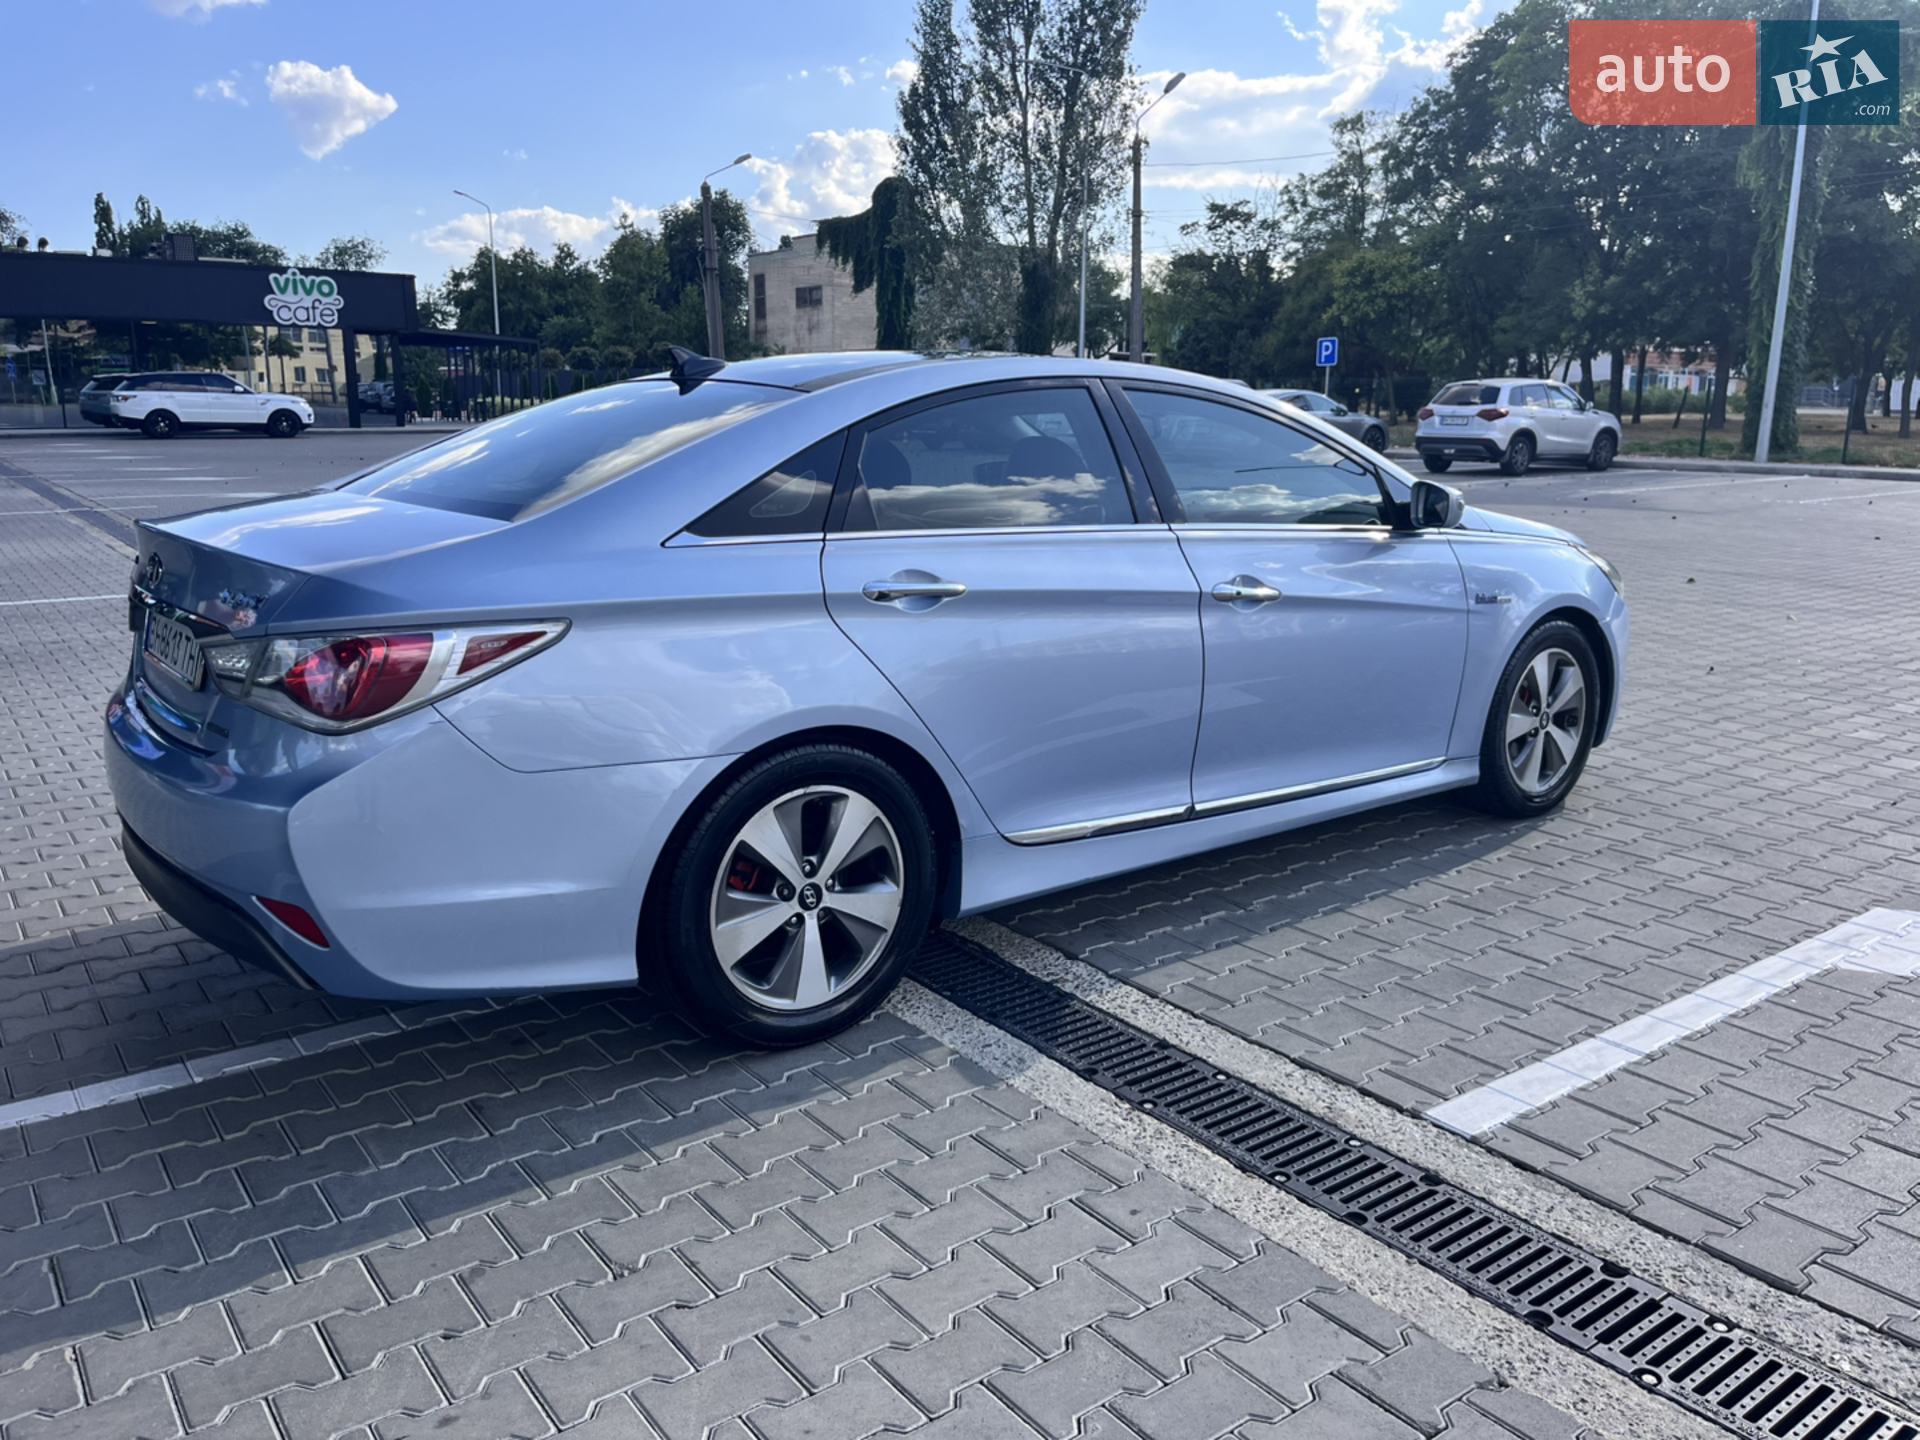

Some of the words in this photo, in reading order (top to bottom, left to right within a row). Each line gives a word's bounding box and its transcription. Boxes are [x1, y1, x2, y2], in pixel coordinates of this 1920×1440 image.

[272, 271, 335, 298] vivo
[276, 298, 336, 324] cafe
[1321, 341, 1333, 363] P
